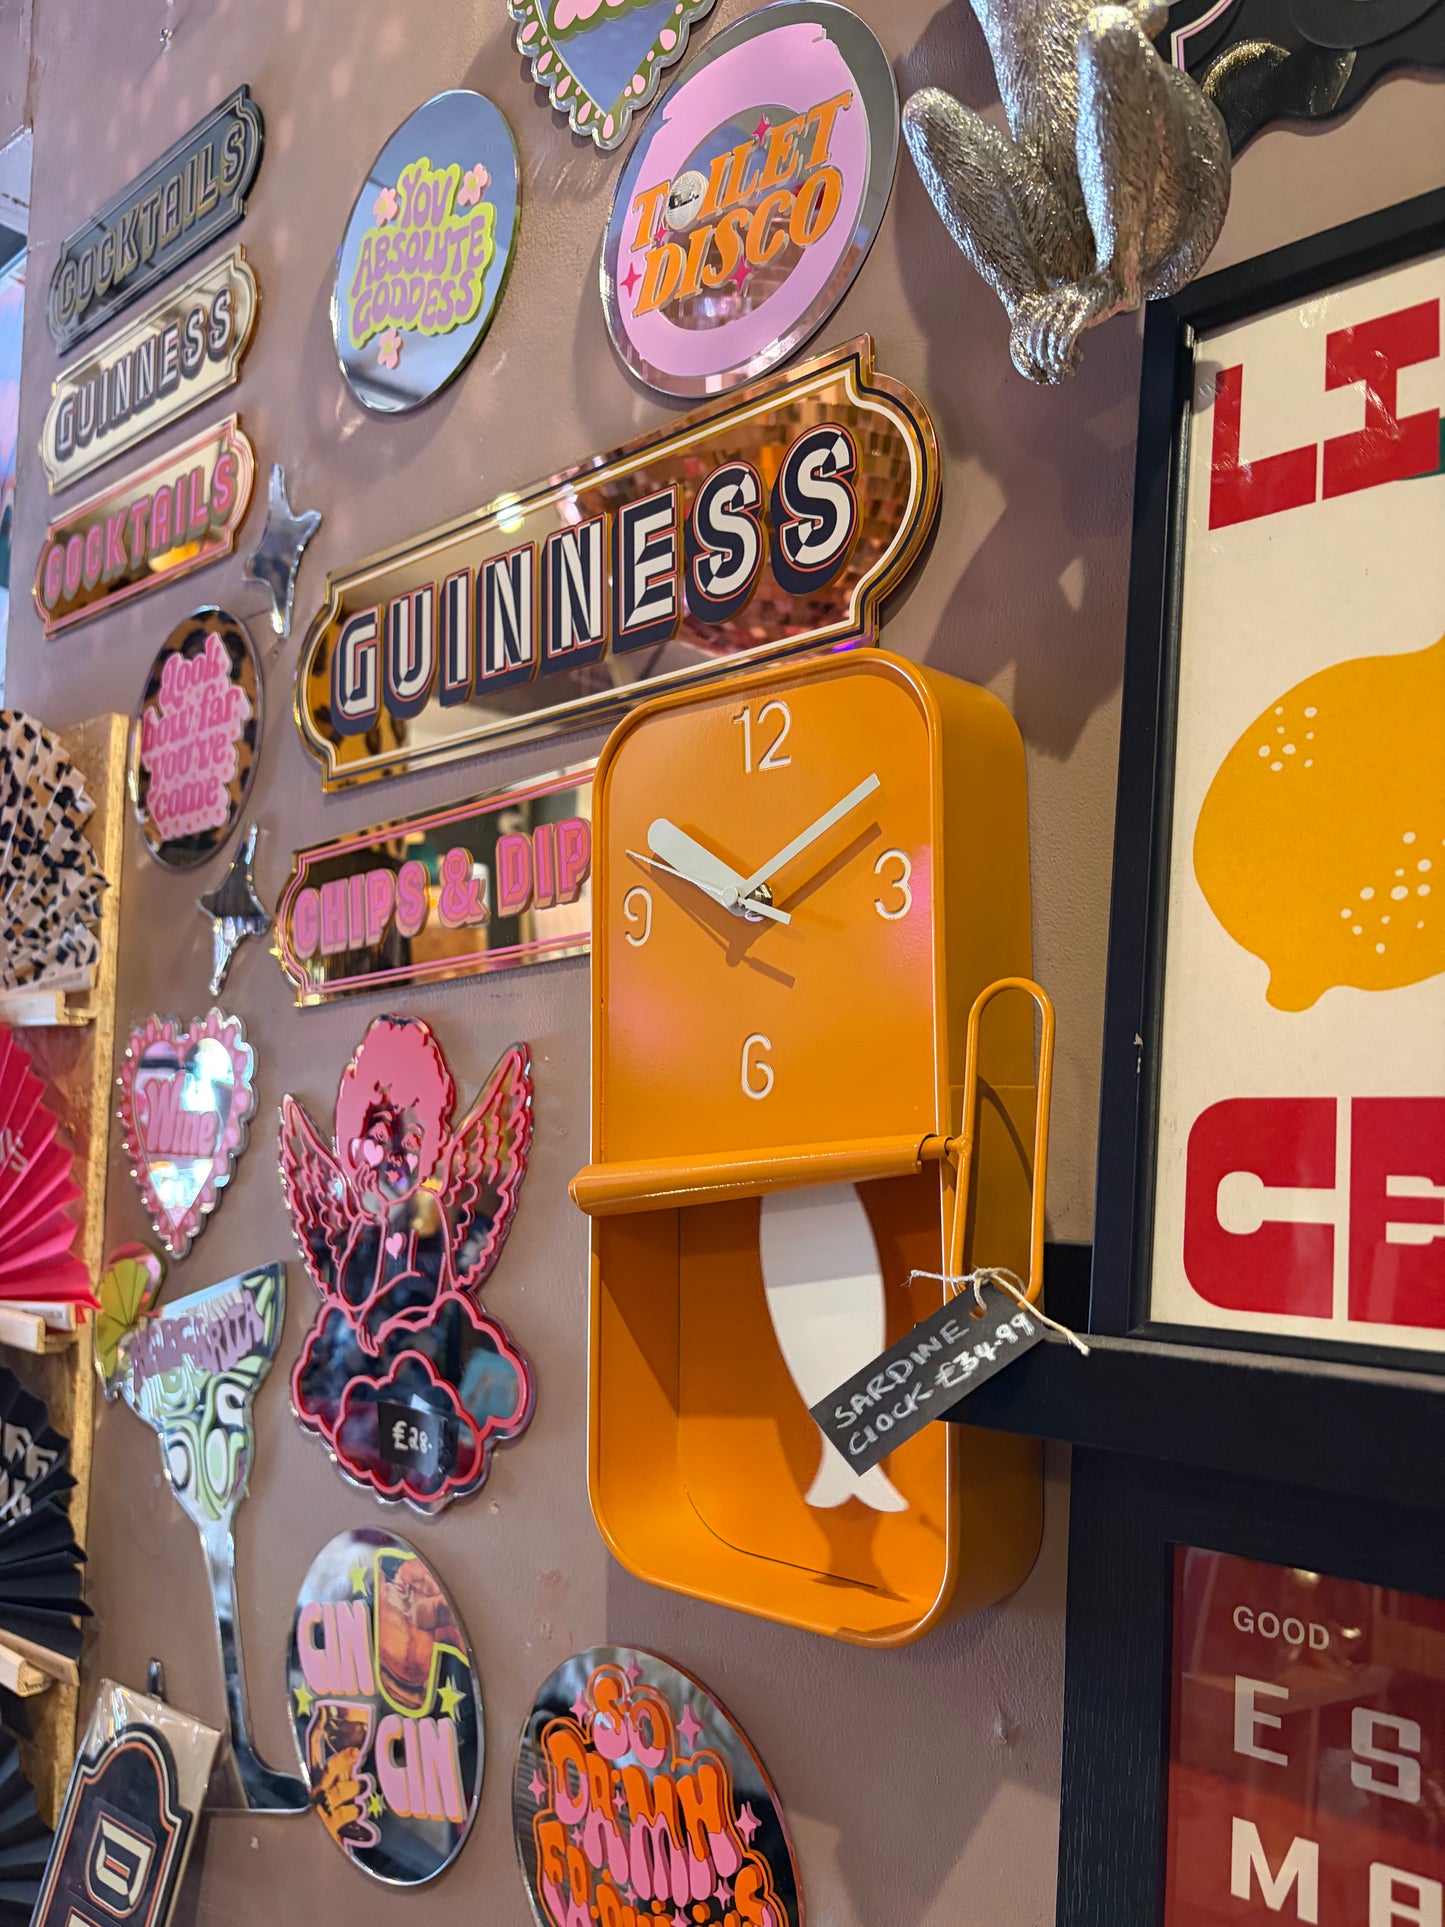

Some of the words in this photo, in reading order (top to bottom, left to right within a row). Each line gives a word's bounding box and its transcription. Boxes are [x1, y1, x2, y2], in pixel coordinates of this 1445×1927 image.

[401, 167, 453, 229] YOU
[630, 90, 853, 253] TOILET
[56, 119, 247, 325] COCKTAILS
[352, 215, 485, 298] ABSOLUTE
[631, 167, 842, 317] DISCO
[353, 268, 475, 339] GODDESS
[55, 287, 234, 462] GUINNESS
[45, 452, 237, 609] COCKTAILS
[331, 422, 863, 734] GUINNESS
[141, 703, 195, 754] how
[199, 684, 241, 732] far
[731, 700, 793, 774] 12
[154, 775, 220, 822] come
[293, 868, 430, 960] CHIPS
[438, 847, 492, 929] &
[622, 885, 654, 948] 9
[873, 848, 913, 920] 3
[740, 1031, 775, 1101] 6
[833, 1318, 970, 1429] SARDINE
[1232, 1606, 1330, 1651] GOOD
[591, 1675, 669, 1769] SO
[546, 1728, 742, 1908] DAMN
